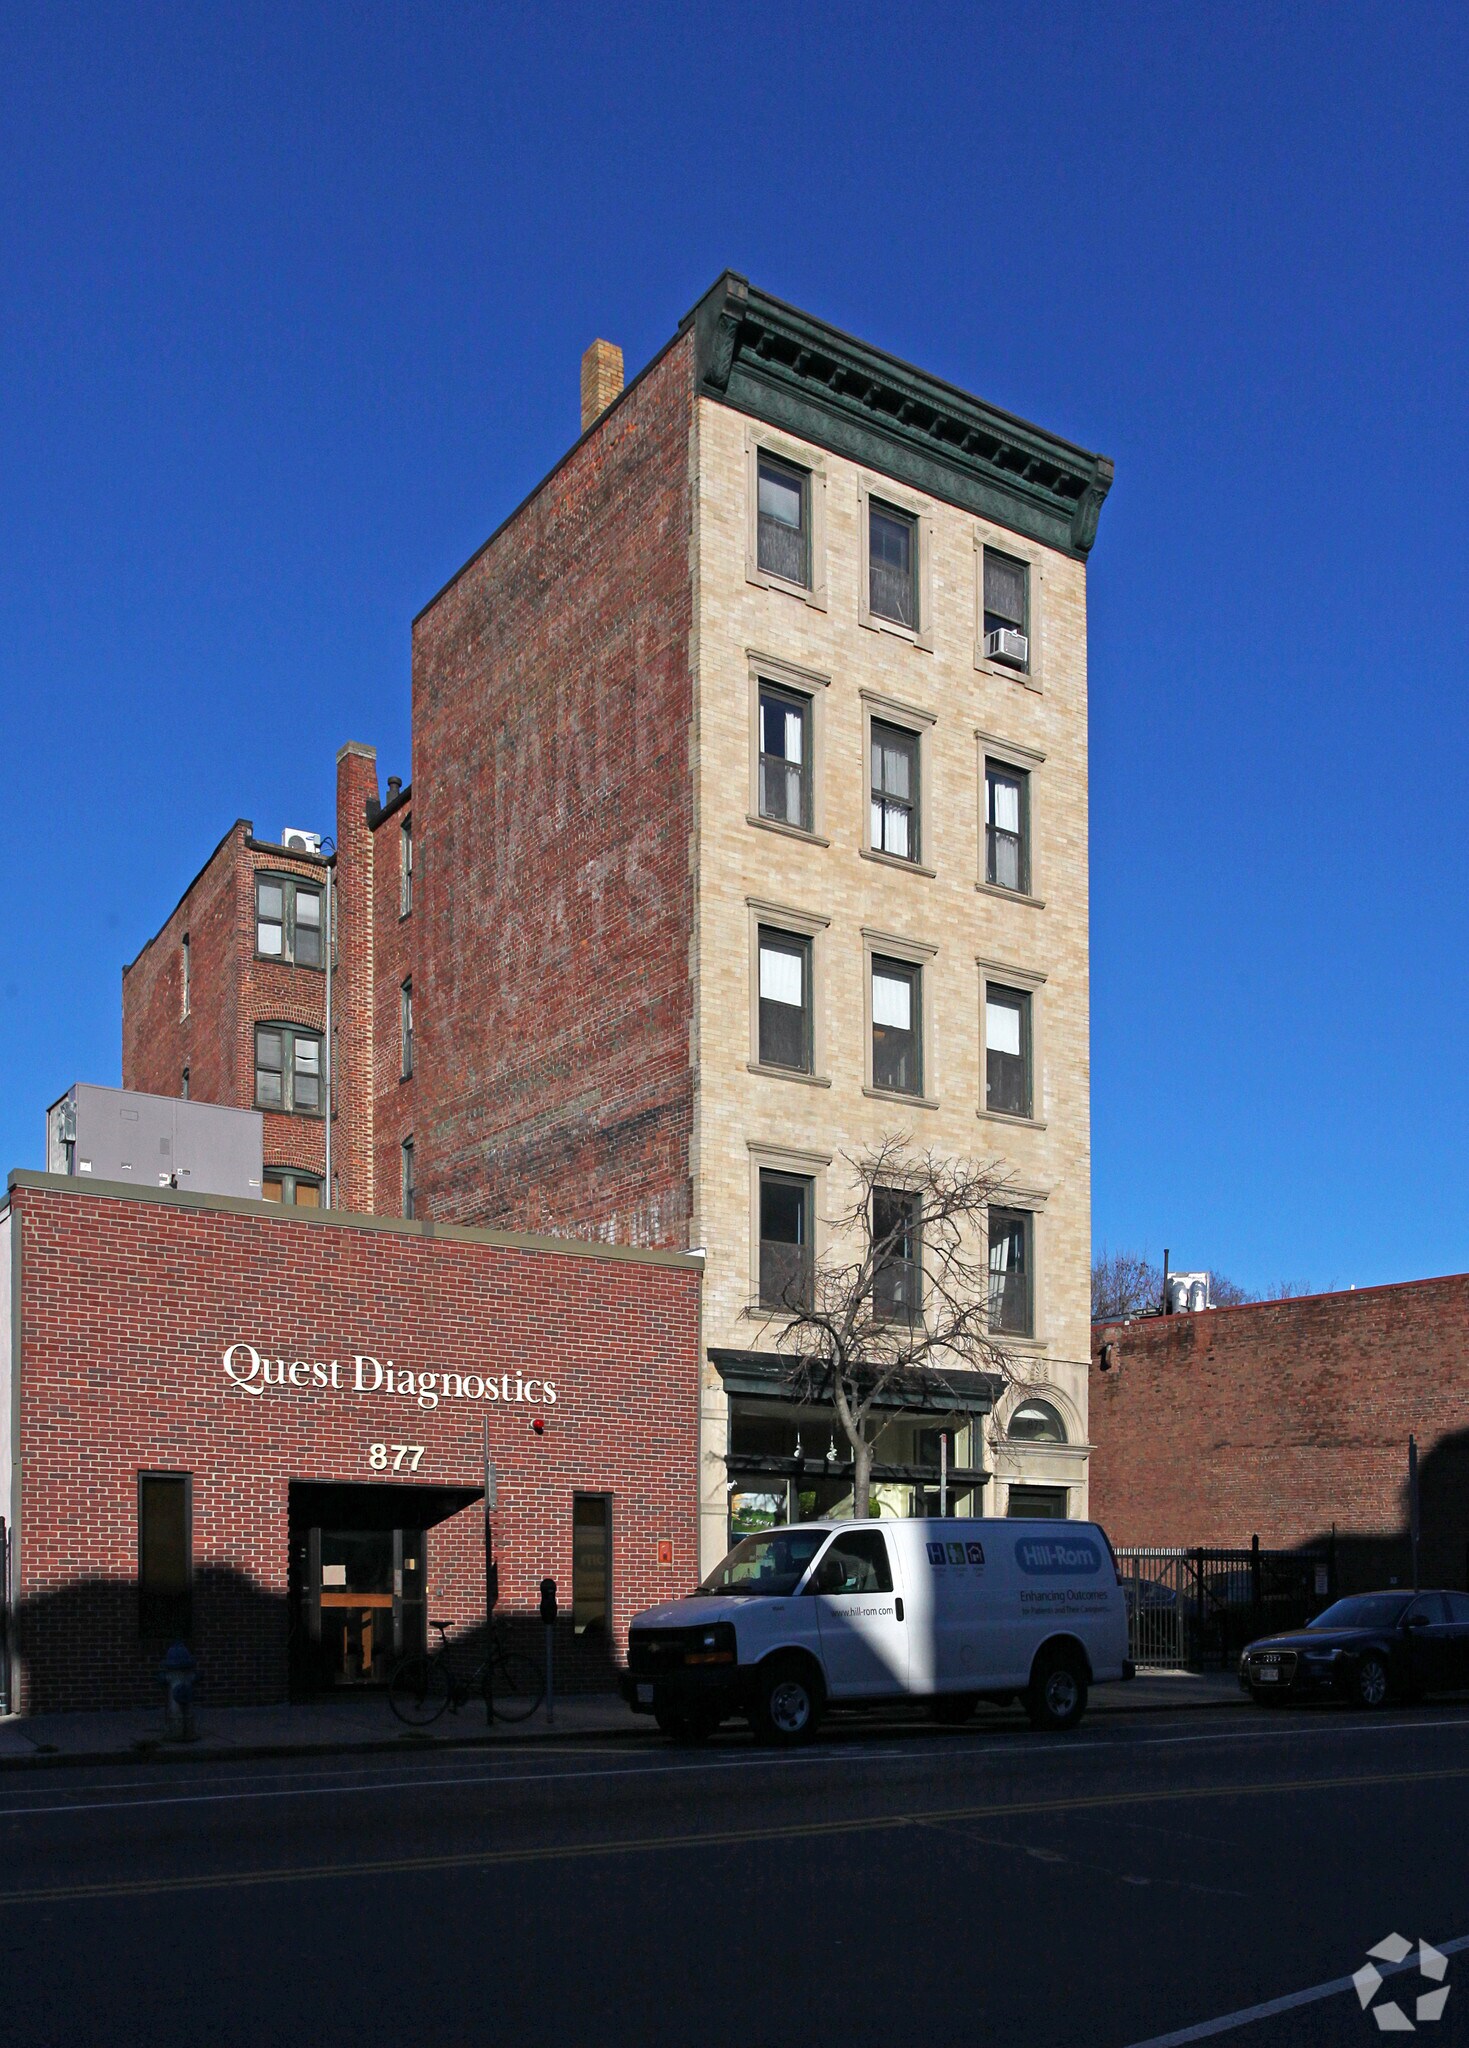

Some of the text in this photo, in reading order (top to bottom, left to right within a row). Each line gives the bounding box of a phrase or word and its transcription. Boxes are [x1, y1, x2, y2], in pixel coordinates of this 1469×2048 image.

[223, 1343, 557, 1410] Quest Diagnostics
[1027, 1419, 1045, 1431] 875
[369, 1443, 425, 1472] 877
[1023, 1545, 1094, 1565] Hill-Rom
[1020, 1589, 1108, 1604] Enhancing Outcomes
[832, 1607, 893, 1617] www.hill-romcom
